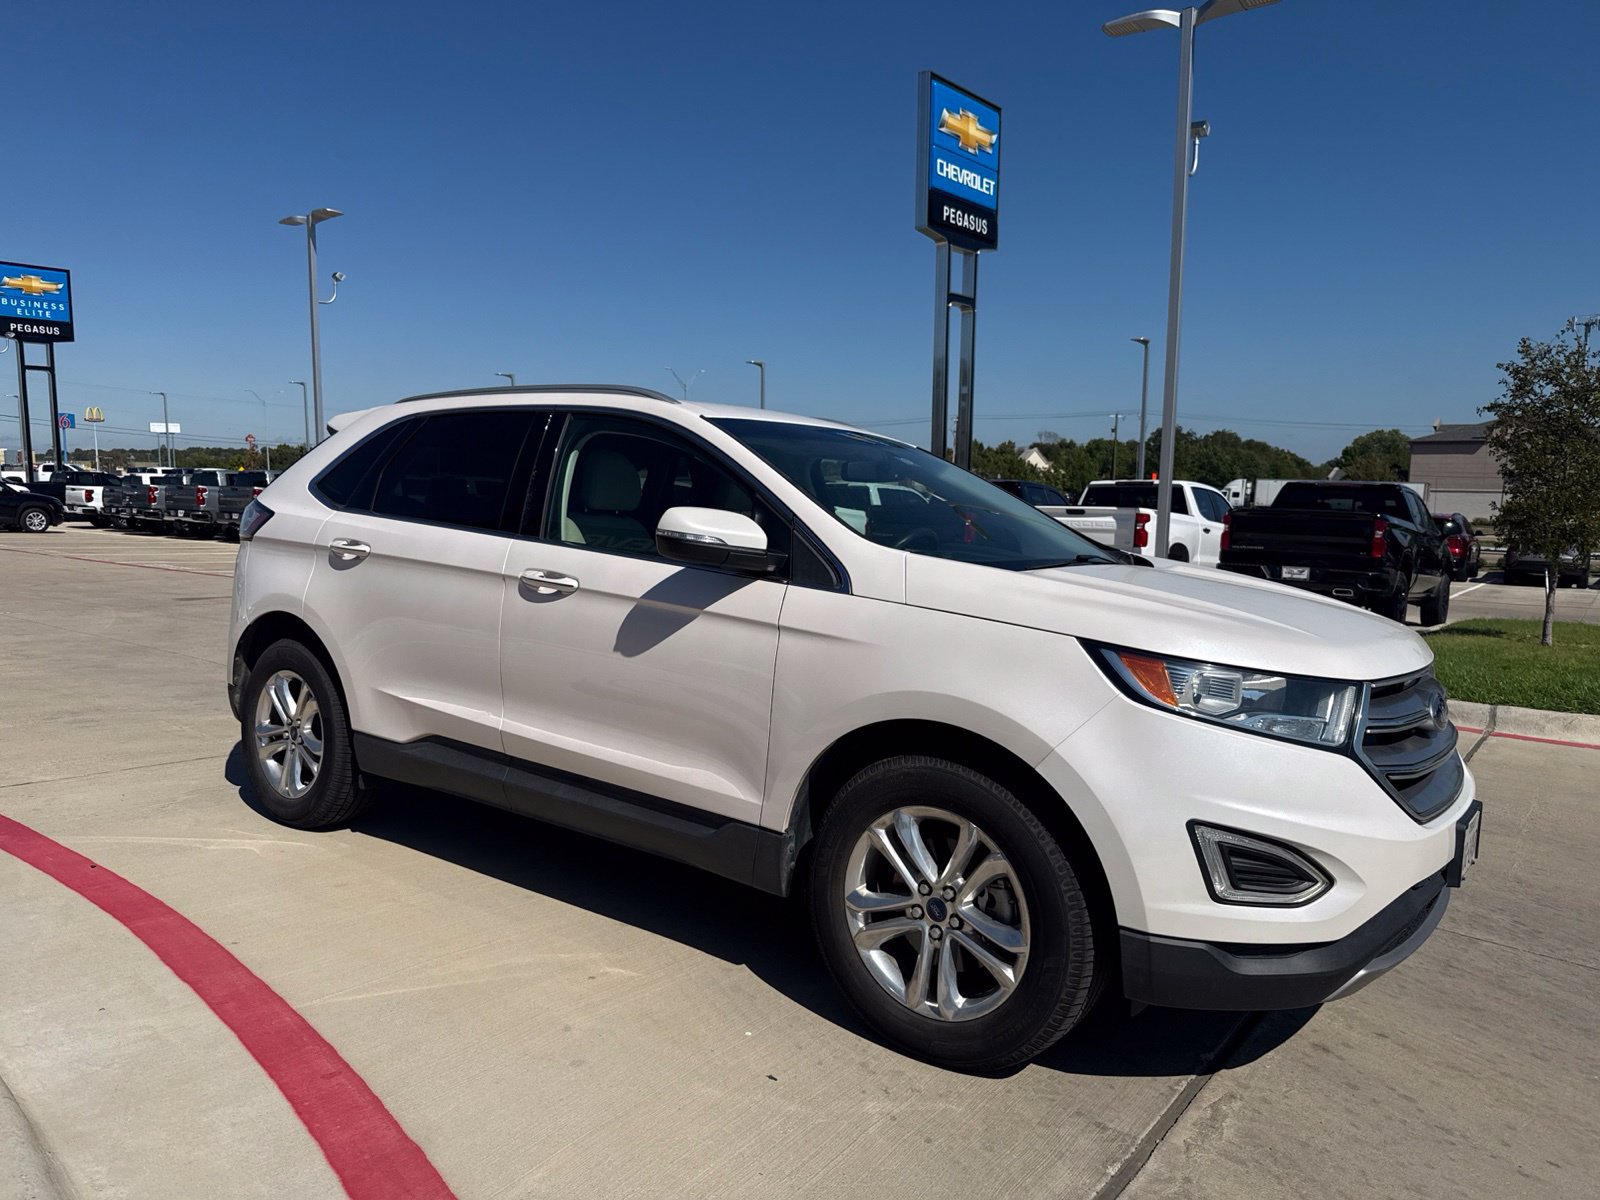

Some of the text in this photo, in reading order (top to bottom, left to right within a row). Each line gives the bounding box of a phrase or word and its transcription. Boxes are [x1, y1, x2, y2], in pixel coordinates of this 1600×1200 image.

[936, 158, 995, 196] CHEVROLET
[943, 205, 988, 235] PEGASUS
[1, 297, 65, 311] BUSINESS
[16, 308, 52, 318] ELITE
[10, 323, 60, 335] PEGASUS
[60, 415, 71, 428] 6
